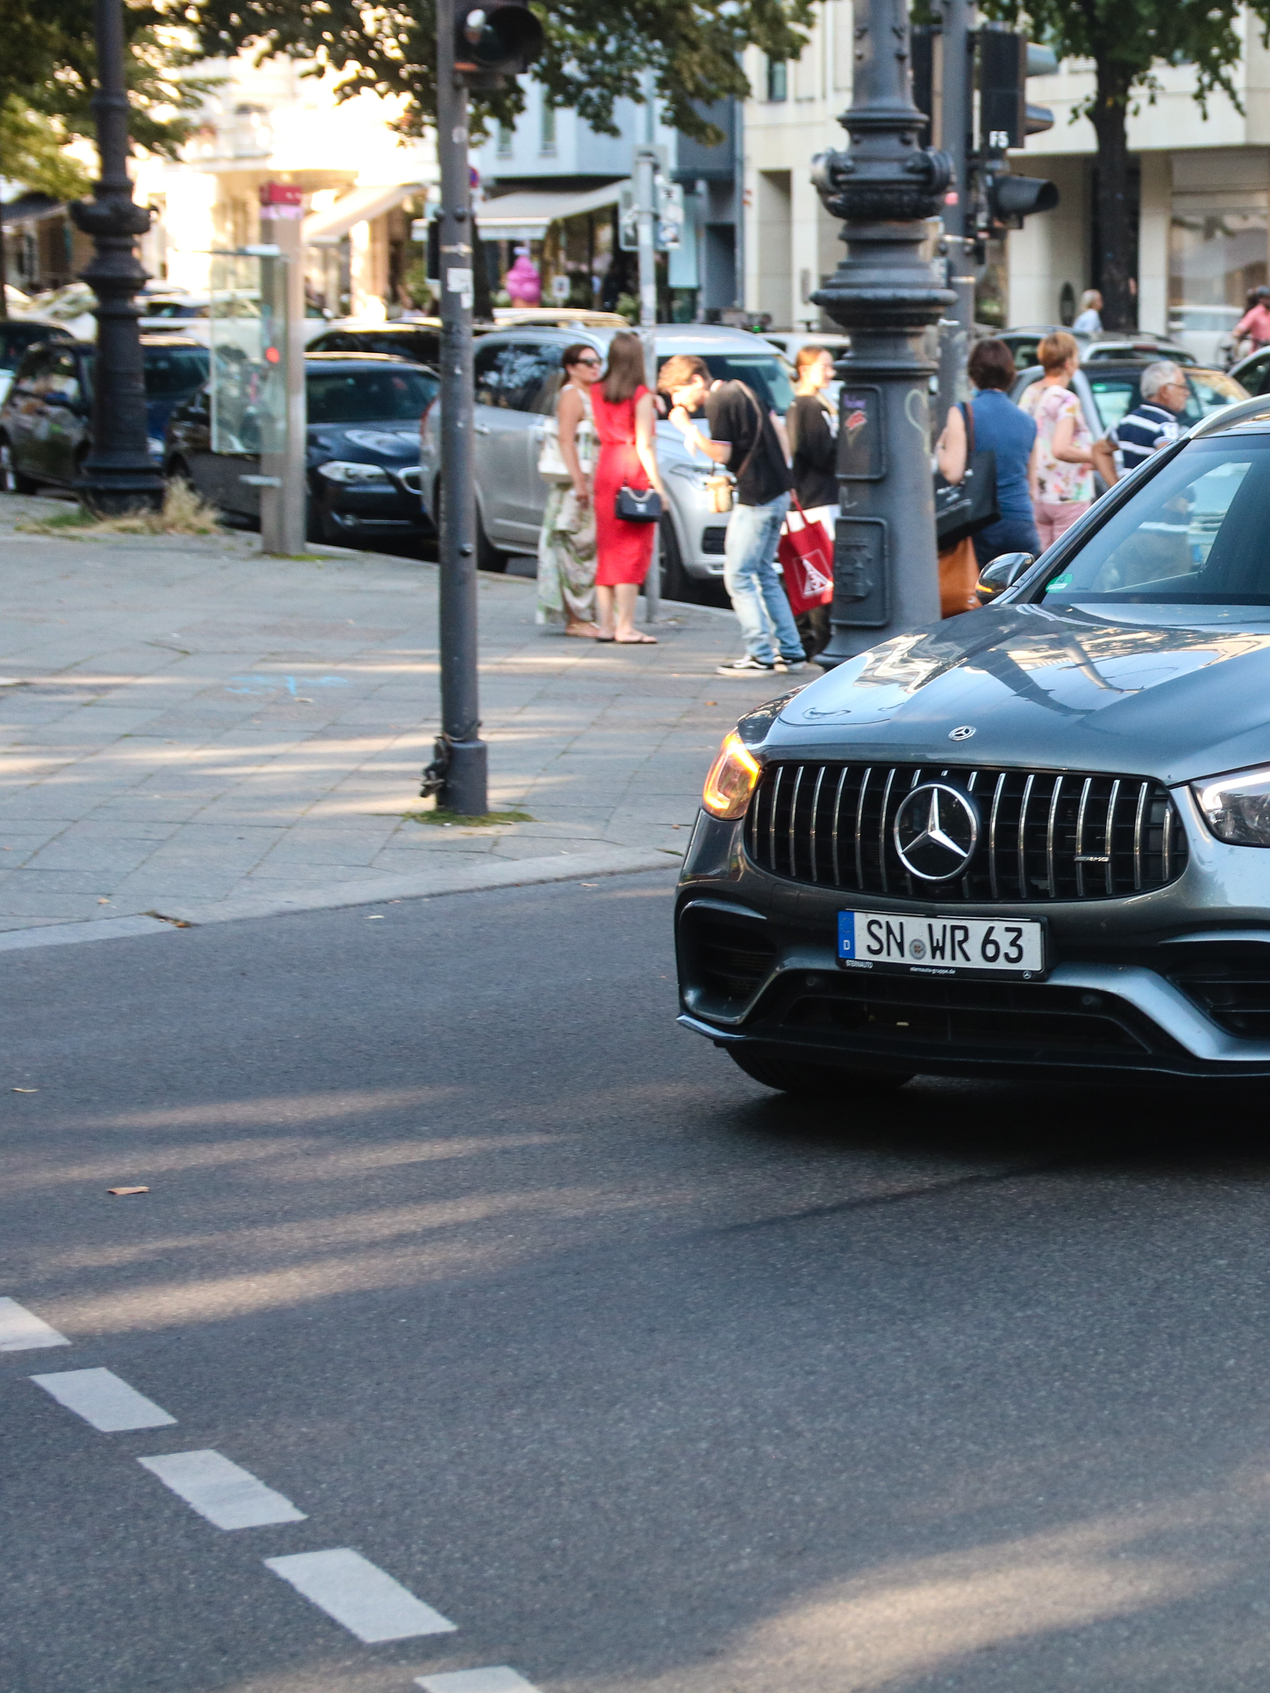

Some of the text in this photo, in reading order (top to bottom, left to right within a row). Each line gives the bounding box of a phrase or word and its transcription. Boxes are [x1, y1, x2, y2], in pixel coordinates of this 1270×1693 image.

[843, 940, 850, 950] D
[866, 919, 1023, 963] SN WR 63
